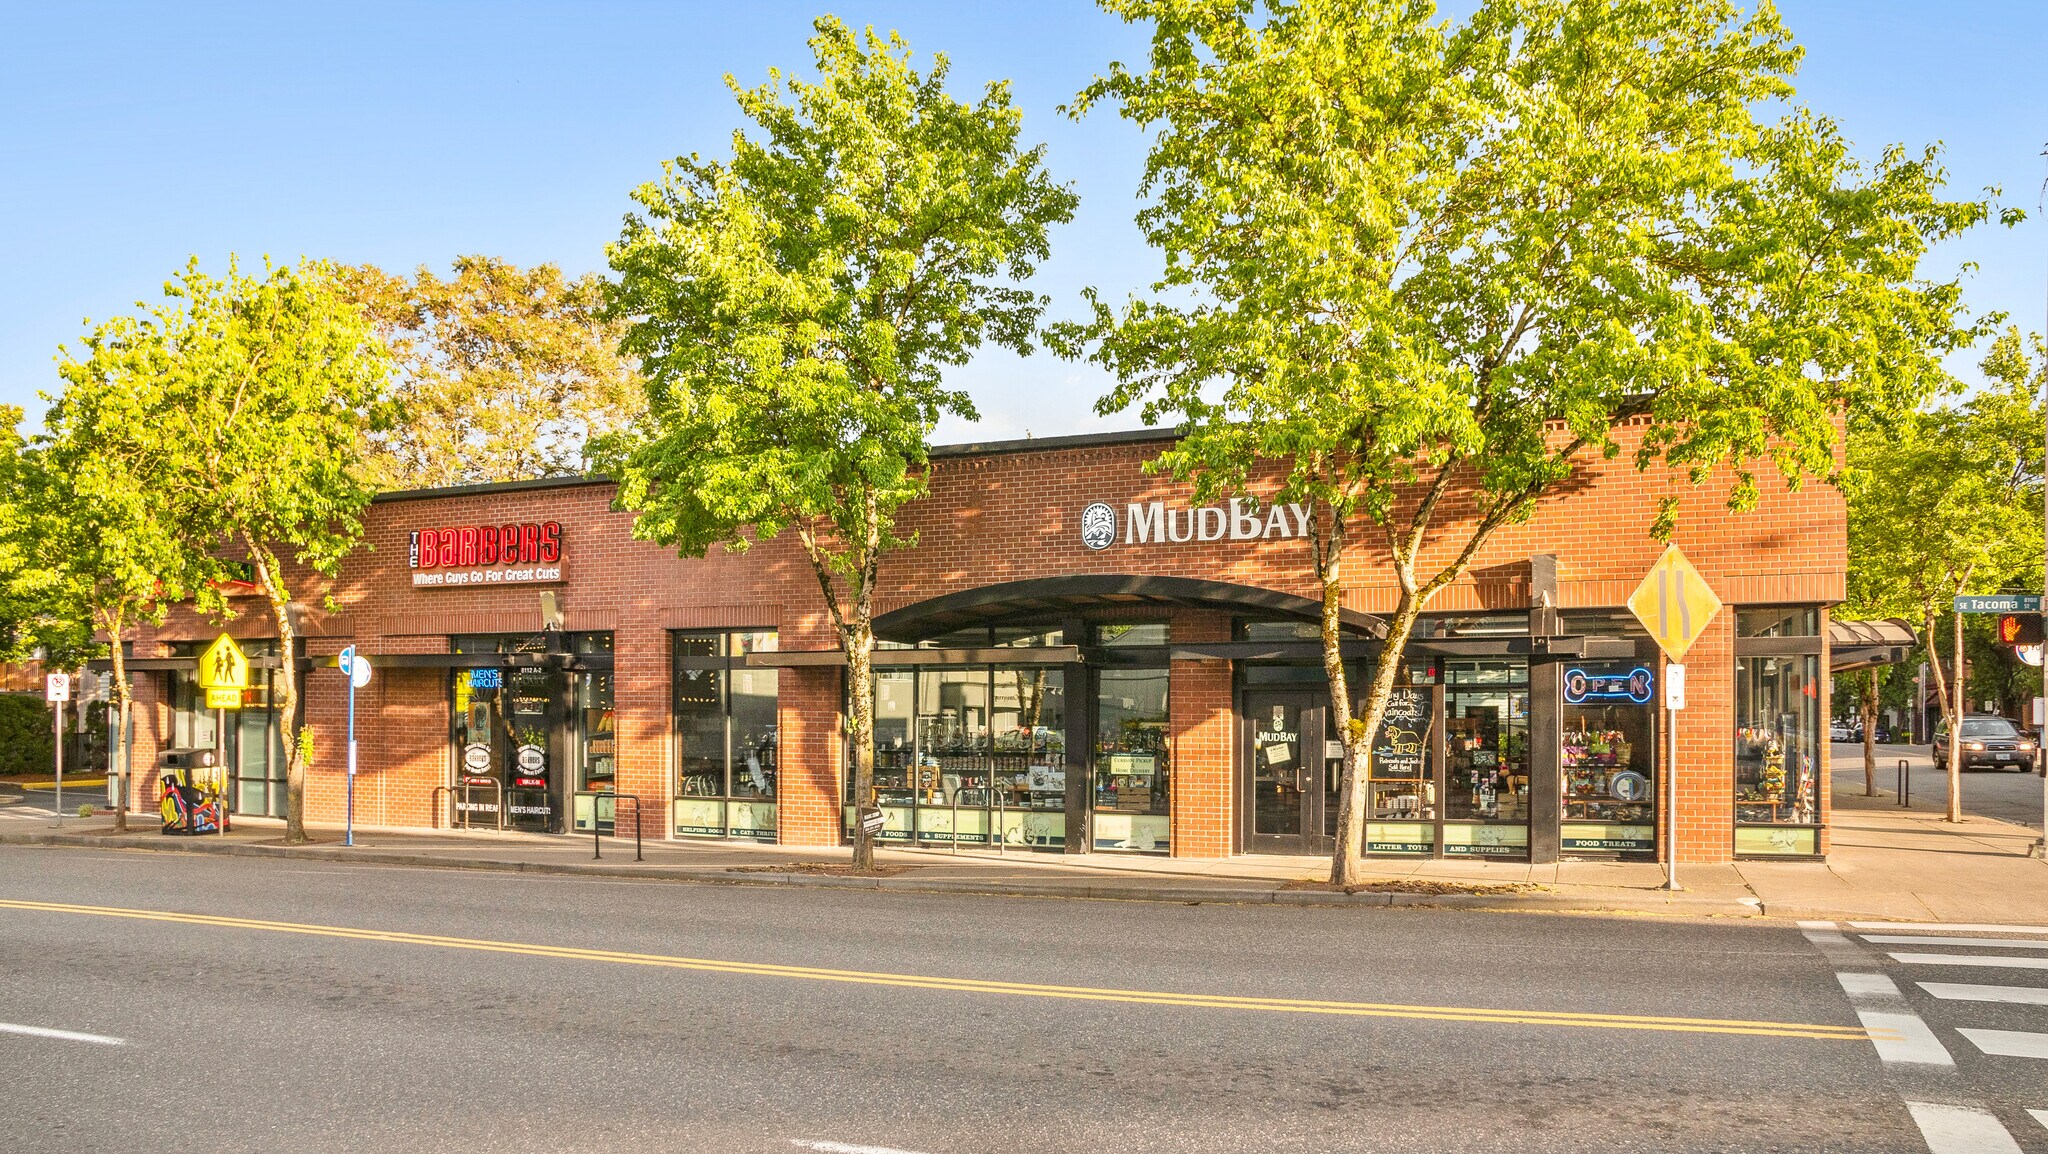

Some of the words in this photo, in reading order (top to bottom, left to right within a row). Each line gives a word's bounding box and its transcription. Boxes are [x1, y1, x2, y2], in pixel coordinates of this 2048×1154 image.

[409, 531, 420, 568] THE
[412, 573, 444, 585] Where
[445, 571, 469, 585] Guys
[470, 570, 484, 583] Go
[486, 569, 503, 582] For
[505, 568, 534, 581] Great
[535, 567, 560, 580] Cuts
[1971, 600, 2018, 609] Tacoma
[470, 669, 498, 679] MEN'S
[467, 678, 502, 688] HAIRCUTS
[1570, 675, 1645, 695] OPEN
[211, 694, 237, 702] AHEAD
[1403, 688, 1424, 702] Days
[510, 805, 527, 814] MEN'S
[885, 830, 908, 838] FOODS
[1602, 840, 1637, 848] TREATS
